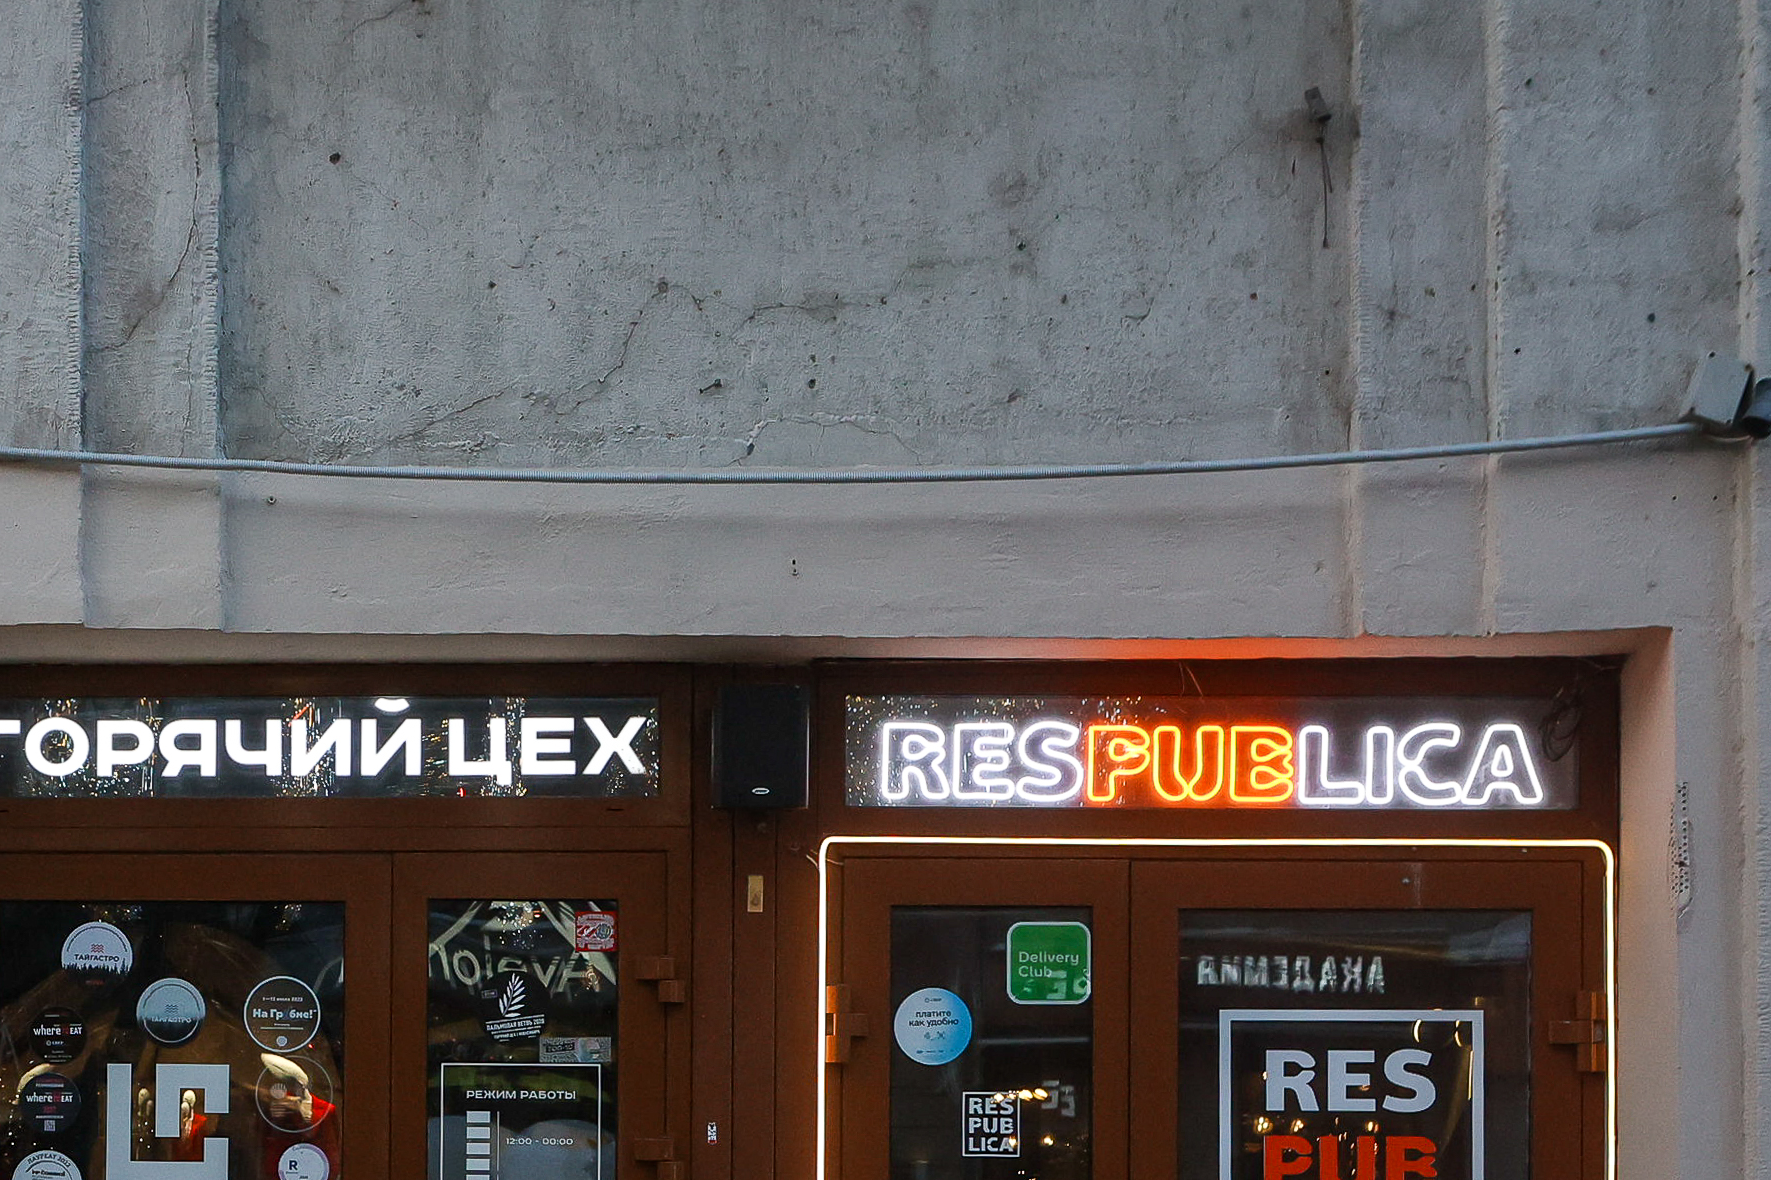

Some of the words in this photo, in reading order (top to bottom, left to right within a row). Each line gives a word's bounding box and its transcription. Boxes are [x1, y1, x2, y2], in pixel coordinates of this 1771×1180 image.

[448, 716, 646, 786] ЦЕХ
[880, 720, 1543, 805] RESPUBLICA
[74, 953, 120, 962] ТАЙГАСТРО
[1018, 951, 1079, 965] Delivery
[1018, 966, 1052, 978] Club
[915, 1010, 952, 1018] платите
[909, 1019, 926, 1027] как
[926, 1017, 960, 1028] удобно
[33, 1024, 62, 1036] where
[69, 1026, 83, 1035] EAT
[1265, 1048, 1437, 1113] RES
[26, 1091, 53, 1103] where
[61, 1095, 74, 1103] EAT
[466, 1090, 517, 1100] РЕЖИМ
[520, 1090, 577, 1100] РАБОТЫ
[968, 1098, 1014, 1115] RES
[968, 1118, 1014, 1134] PUB
[968, 1137, 1014, 1152] LICA
[289, 1160, 298, 1171] R
